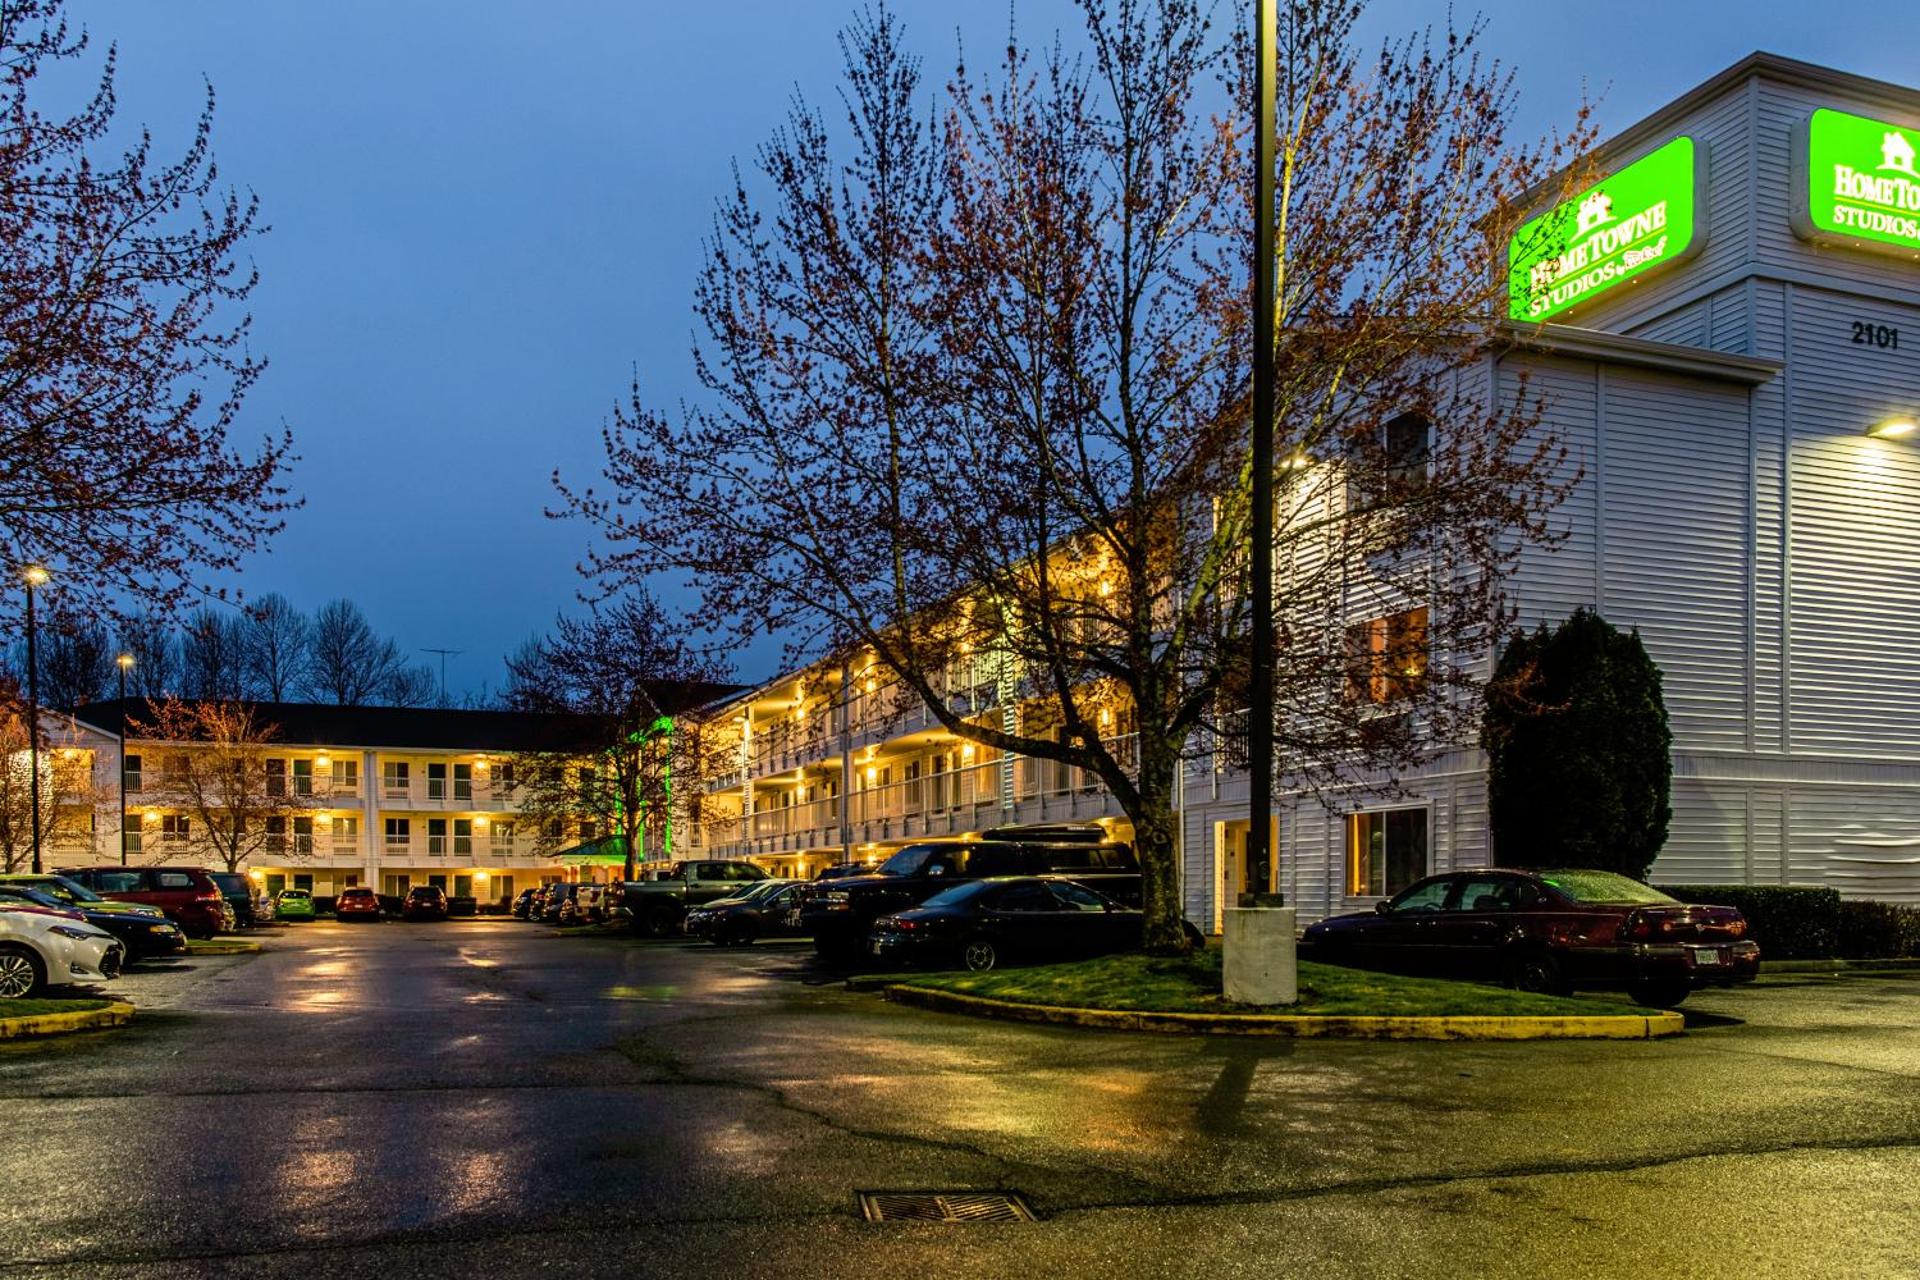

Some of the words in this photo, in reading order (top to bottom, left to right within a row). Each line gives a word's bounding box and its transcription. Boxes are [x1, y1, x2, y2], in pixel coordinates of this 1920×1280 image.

[1833, 205, 1917, 239] STUDIOS
[1529, 261, 1616, 317] STUDIOS
[1851, 321, 1898, 350] 2101
